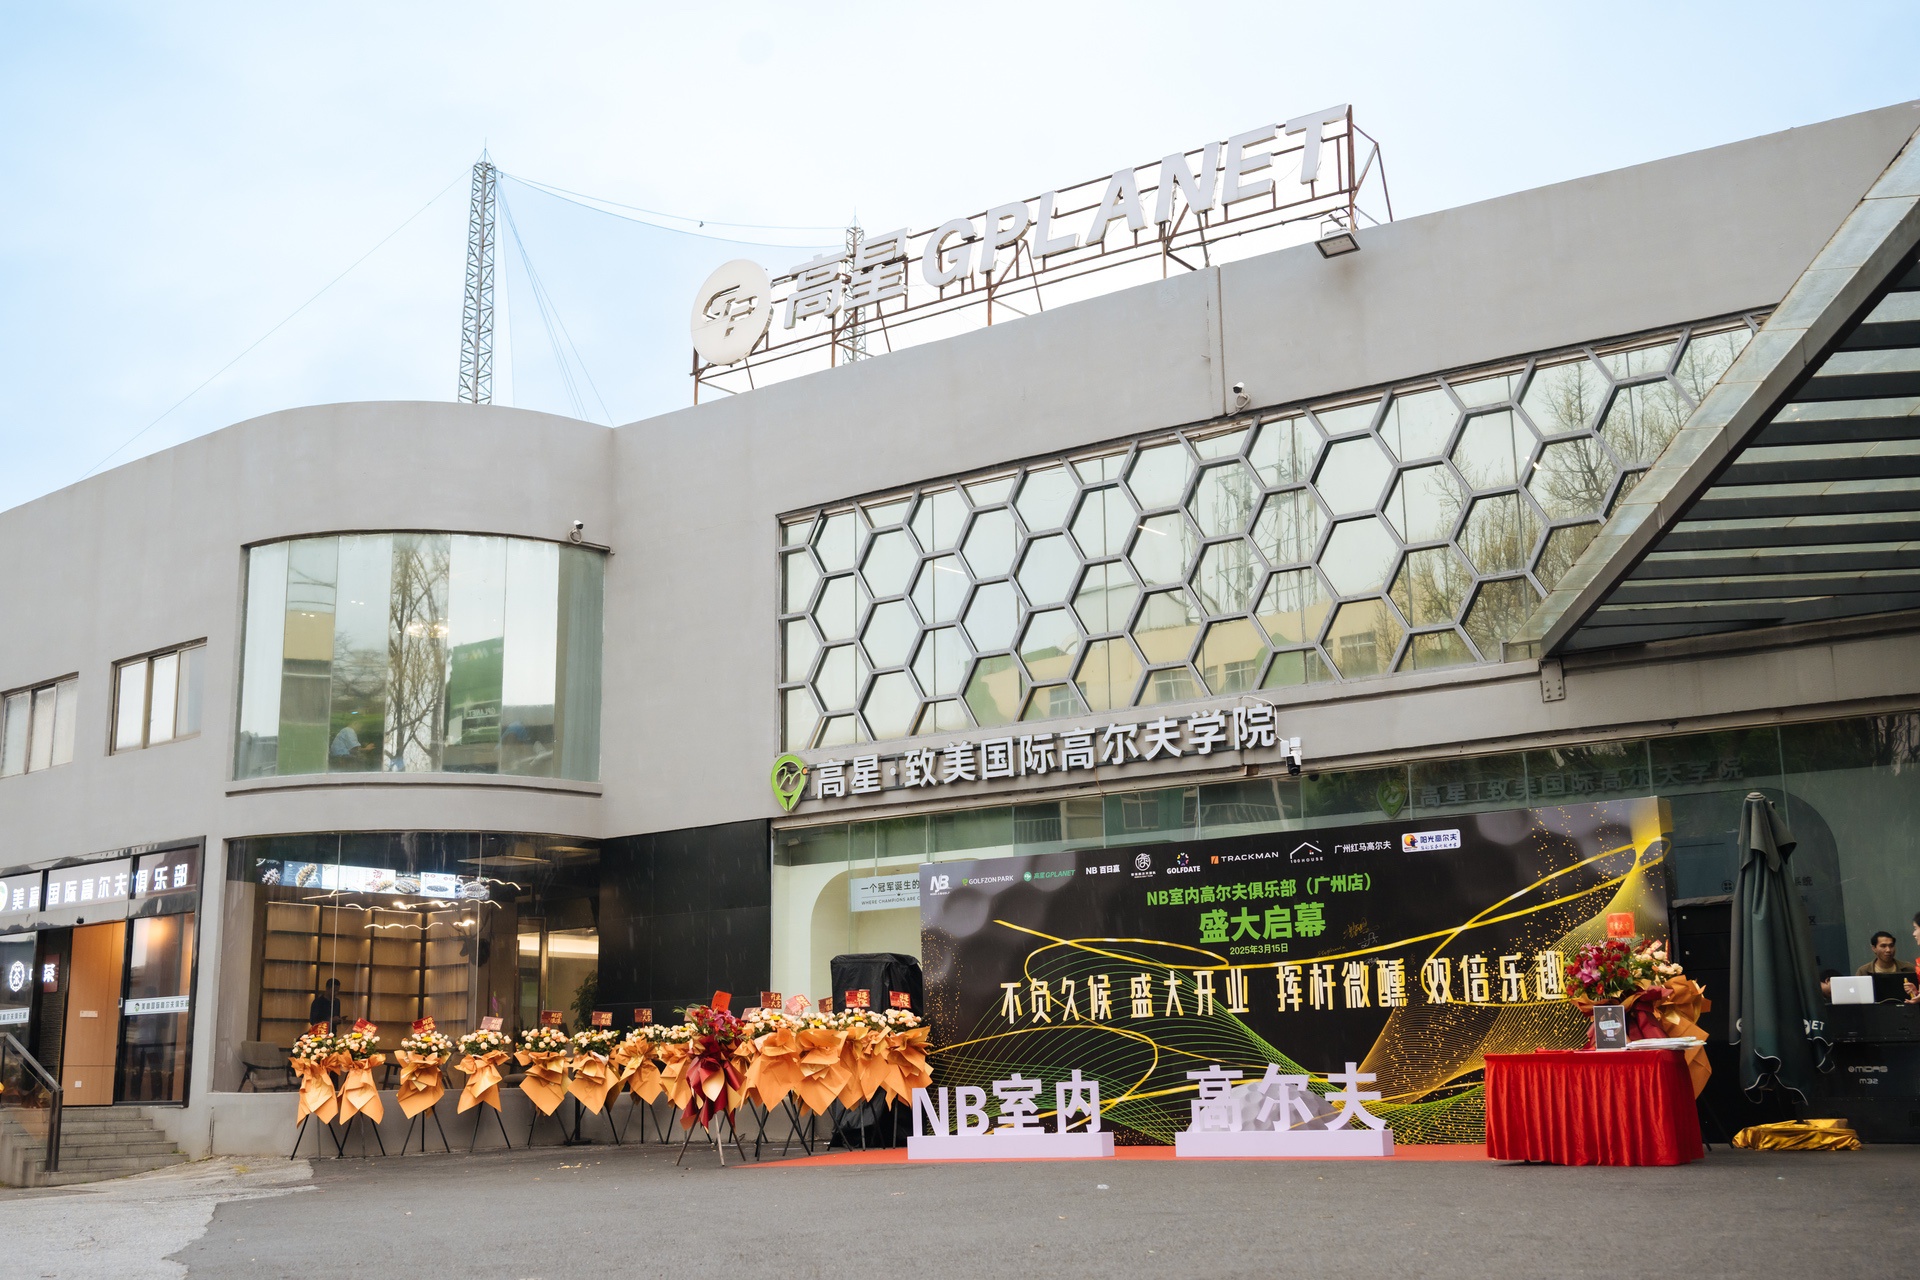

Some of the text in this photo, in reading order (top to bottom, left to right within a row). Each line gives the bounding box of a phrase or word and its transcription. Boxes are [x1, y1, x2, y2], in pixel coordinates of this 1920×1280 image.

[784, 102, 1349, 330] 高星 GPLANET
[1420, 833, 1457, 843] 阳光高尔夫
[1334, 841, 1392, 854] 广州红马高尔夫
[1221, 852, 1279, 863] TRACKMAN
[1046, 869, 1075, 878] GPLANET
[1086, 867, 1098, 875] NB
[1166, 866, 1200, 875] GOLFDATE
[968, 875, 1014, 885] GOLFZON PARK
[879, 896, 905, 904] CHAMPIONS
[1199, 902, 1326, 943] 盛大启幕
[1230, 943, 1289, 955] 2025年3月15日
[1000, 950, 1568, 1025] 不负久候 盛大开业 挥杆微醺 双倍乐趣
[911, 1061, 1387, 1137] NB室内 高尔夫
